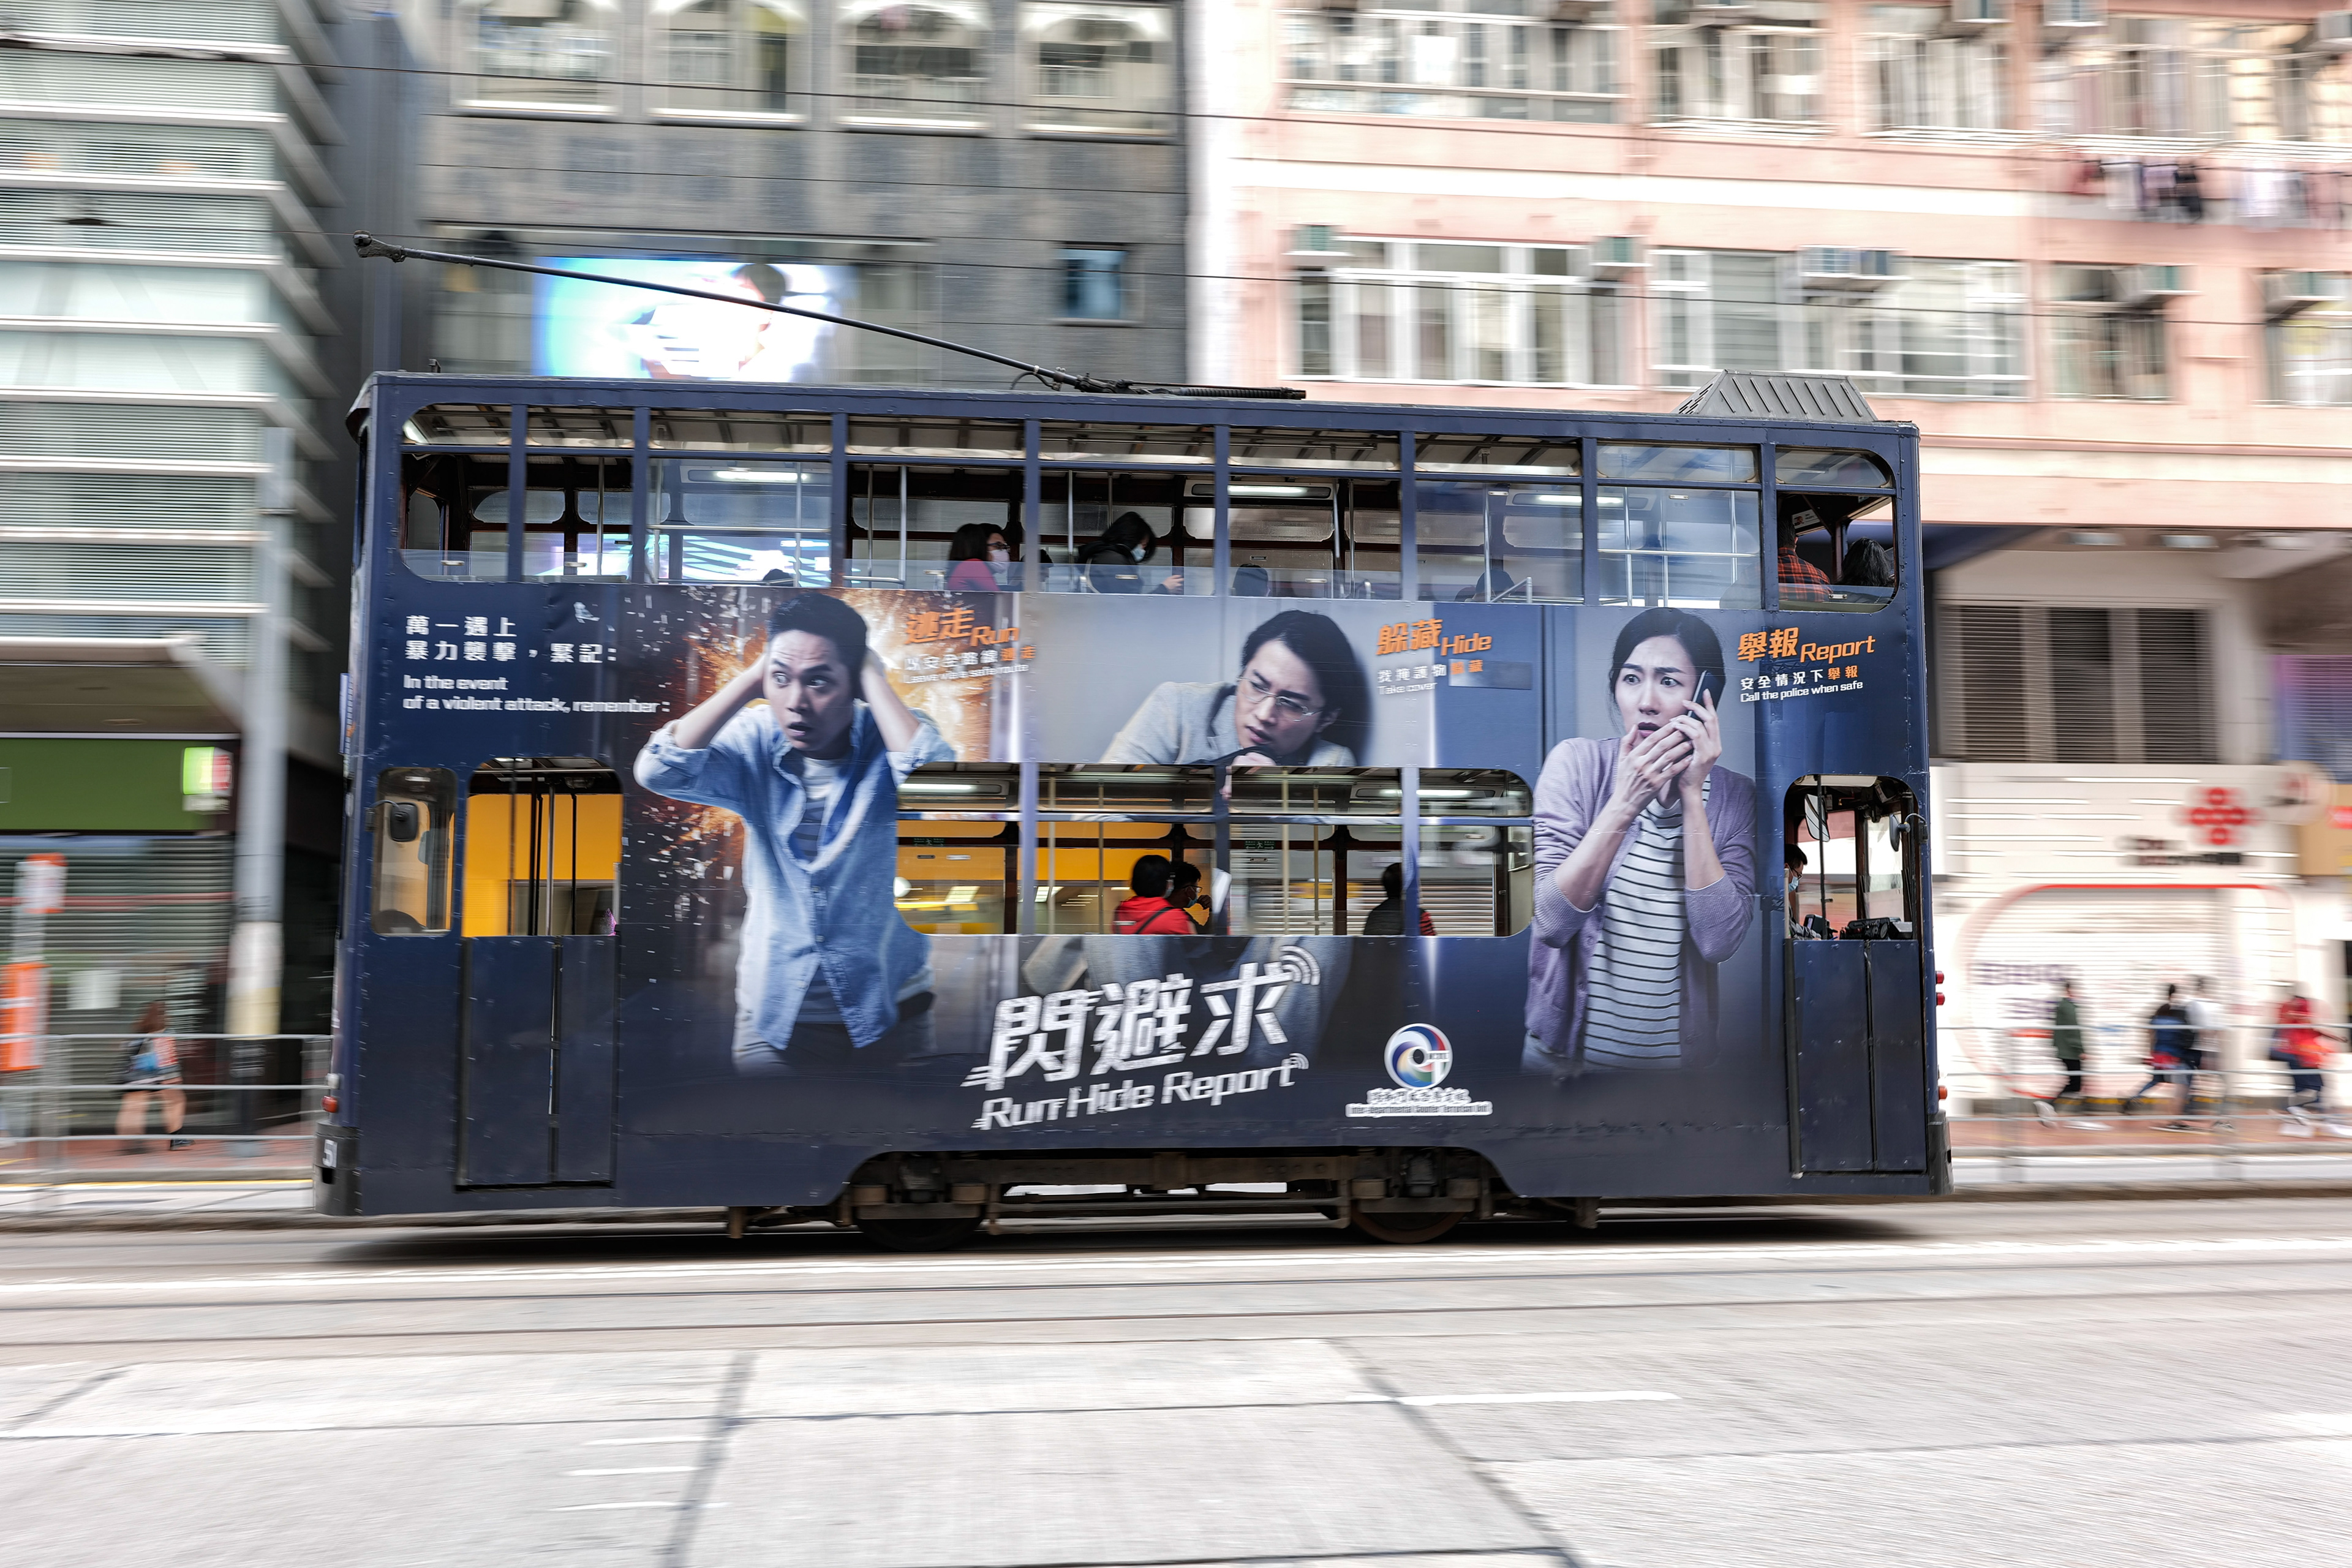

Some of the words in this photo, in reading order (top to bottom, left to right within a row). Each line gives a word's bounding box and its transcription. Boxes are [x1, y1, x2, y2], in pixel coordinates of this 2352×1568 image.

[405, 614, 518, 638] 萬一遇上
[905, 608, 975, 644] 逃走
[971, 626, 1020, 646] Run
[1376, 618, 1443, 655] 躲藏
[1440, 632, 1493, 656] Hide
[1737, 627, 1799, 662] 舉報
[1800, 635, 1876, 663] Report
[403, 674, 421, 689] In
[423, 675, 455, 689] the
[456, 677, 509, 690] event
[1377, 685, 1406, 695] Take
[1406, 683, 1438, 693] cover
[1740, 665, 1858, 691] 安全情況下舉報
[402, 695, 425, 709] of
[425, 699, 440, 709] a
[441, 696, 503, 710] violent
[1740, 692, 1760, 703] Call
[1761, 690, 1779, 700] the
[1780, 687, 1809, 701] police
[1811, 684, 1838, 695] when
[1840, 680, 1863, 692] safe
[974, 1097, 1066, 1131] Run
[1066, 1079, 1155, 1118] Hide
[1161, 1057, 1296, 1106] Report
